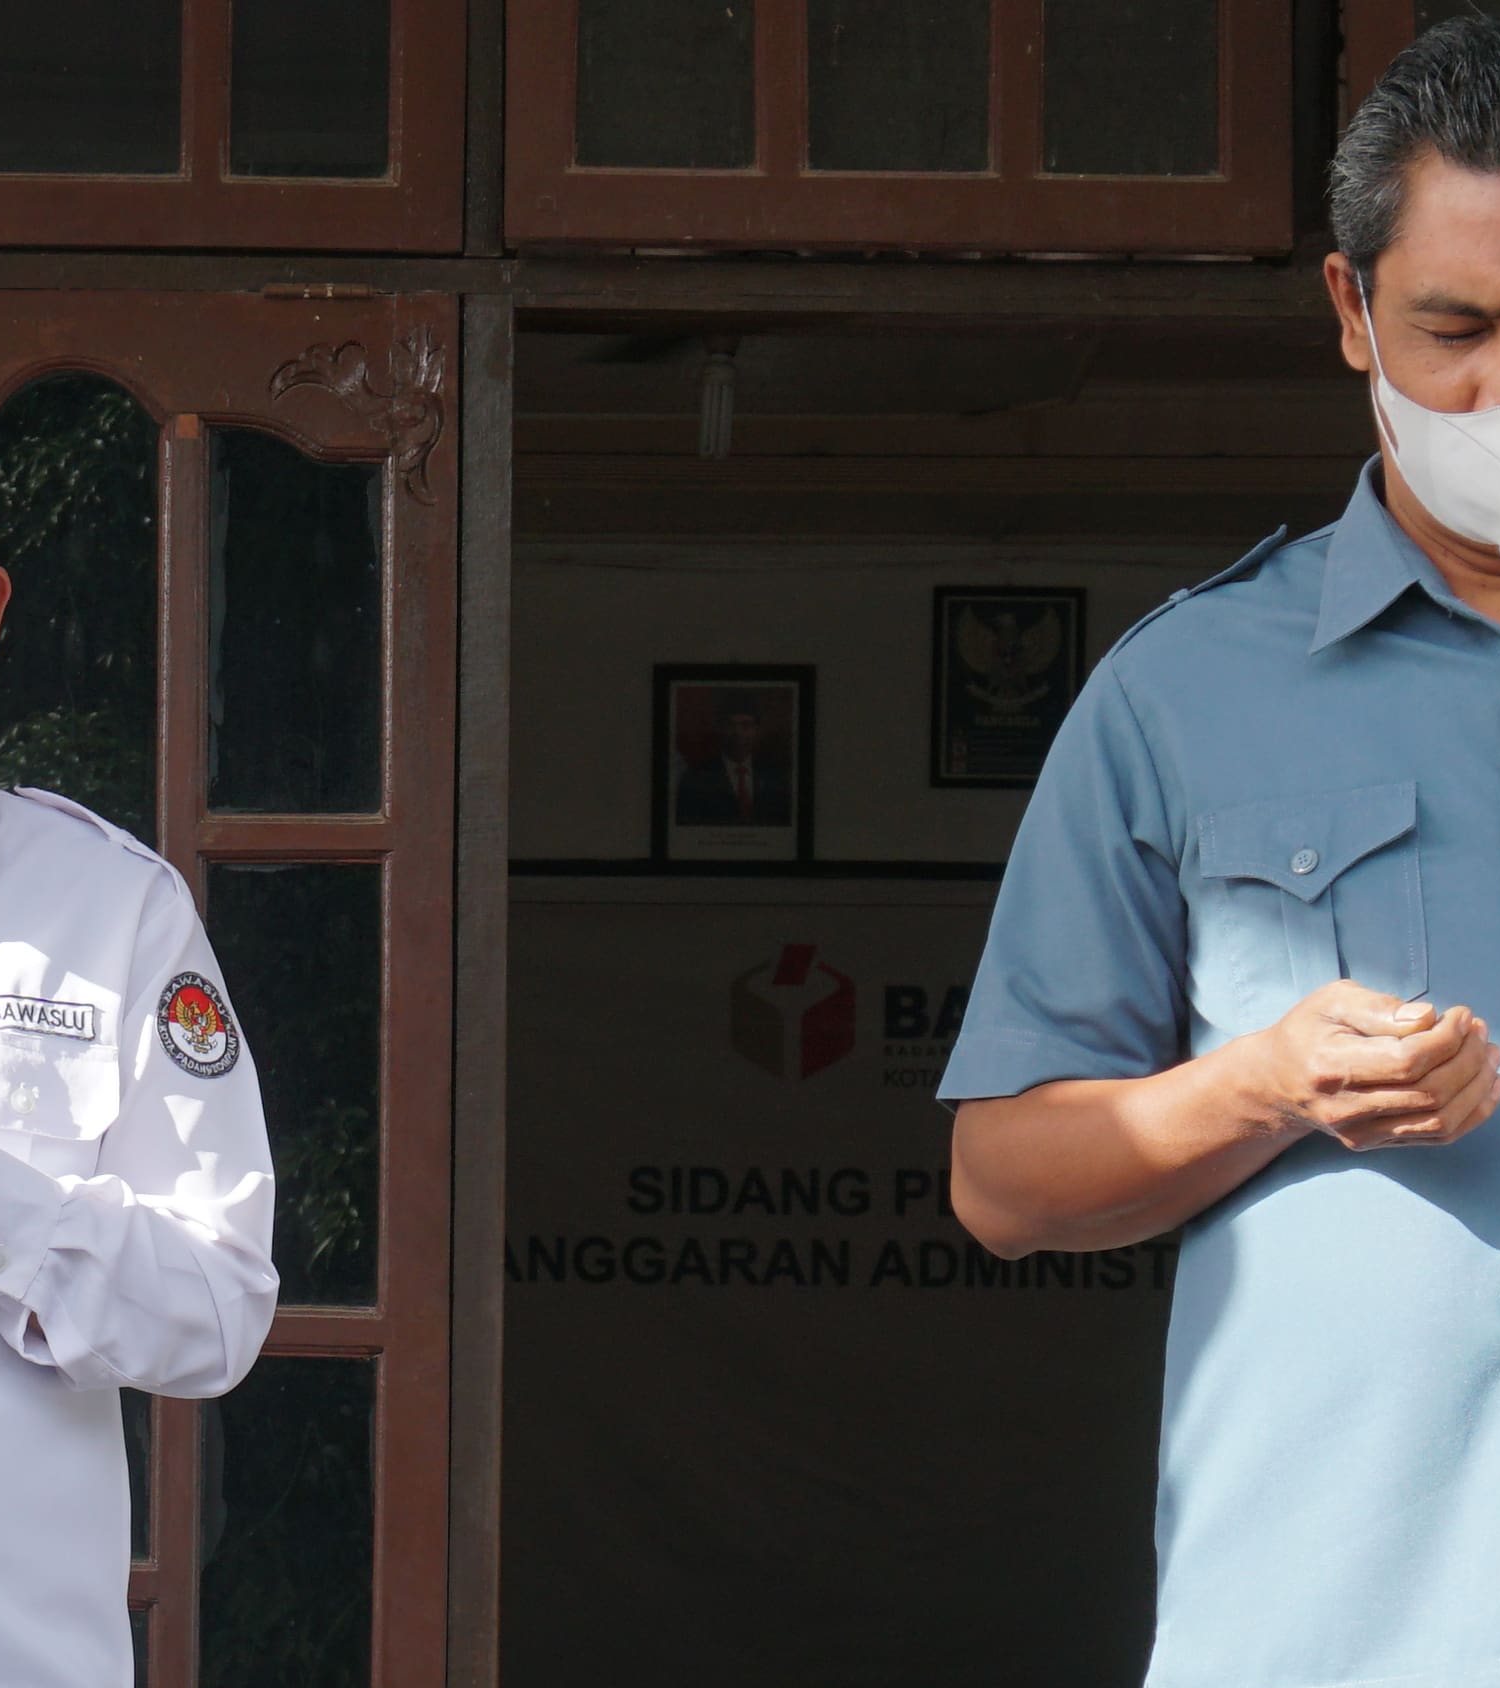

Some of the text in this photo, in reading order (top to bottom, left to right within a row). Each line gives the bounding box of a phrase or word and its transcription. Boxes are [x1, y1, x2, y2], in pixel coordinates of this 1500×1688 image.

[163, 975, 226, 1016] BAWASLU
[885, 985, 968, 1038] BA
[627, 1165, 872, 1215] SIDANG
[868, 1238, 1179, 1289] ADMINIST
